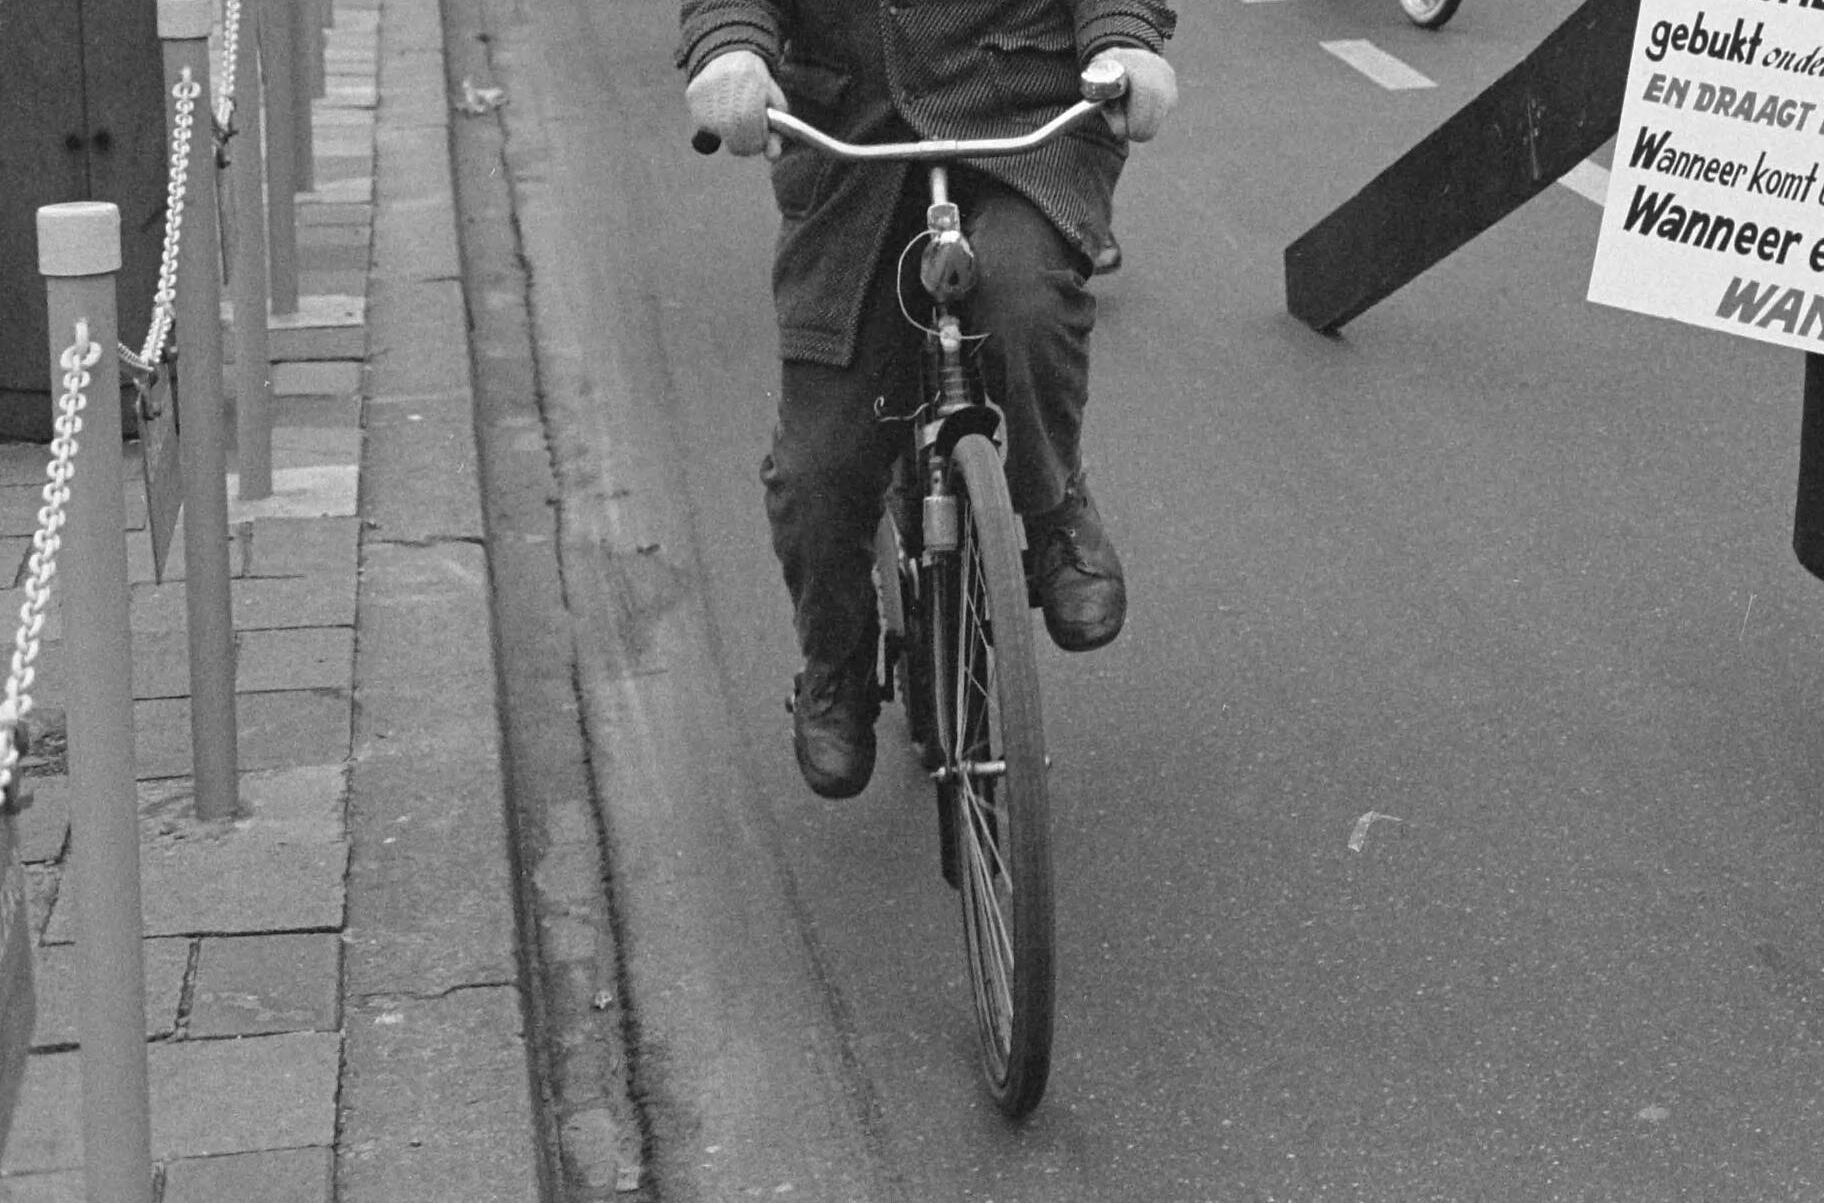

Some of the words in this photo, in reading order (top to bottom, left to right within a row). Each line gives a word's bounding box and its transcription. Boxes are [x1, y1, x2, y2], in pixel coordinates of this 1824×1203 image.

[1643, 9, 1765, 66] gebukt
[1641, 72, 1692, 109] EN
[1692, 81, 1817, 132] DRAAGT
[1627, 124, 1749, 188] Wanneer
[1745, 149, 1820, 203] komt
[1621, 183, 1804, 265] Wanneer
